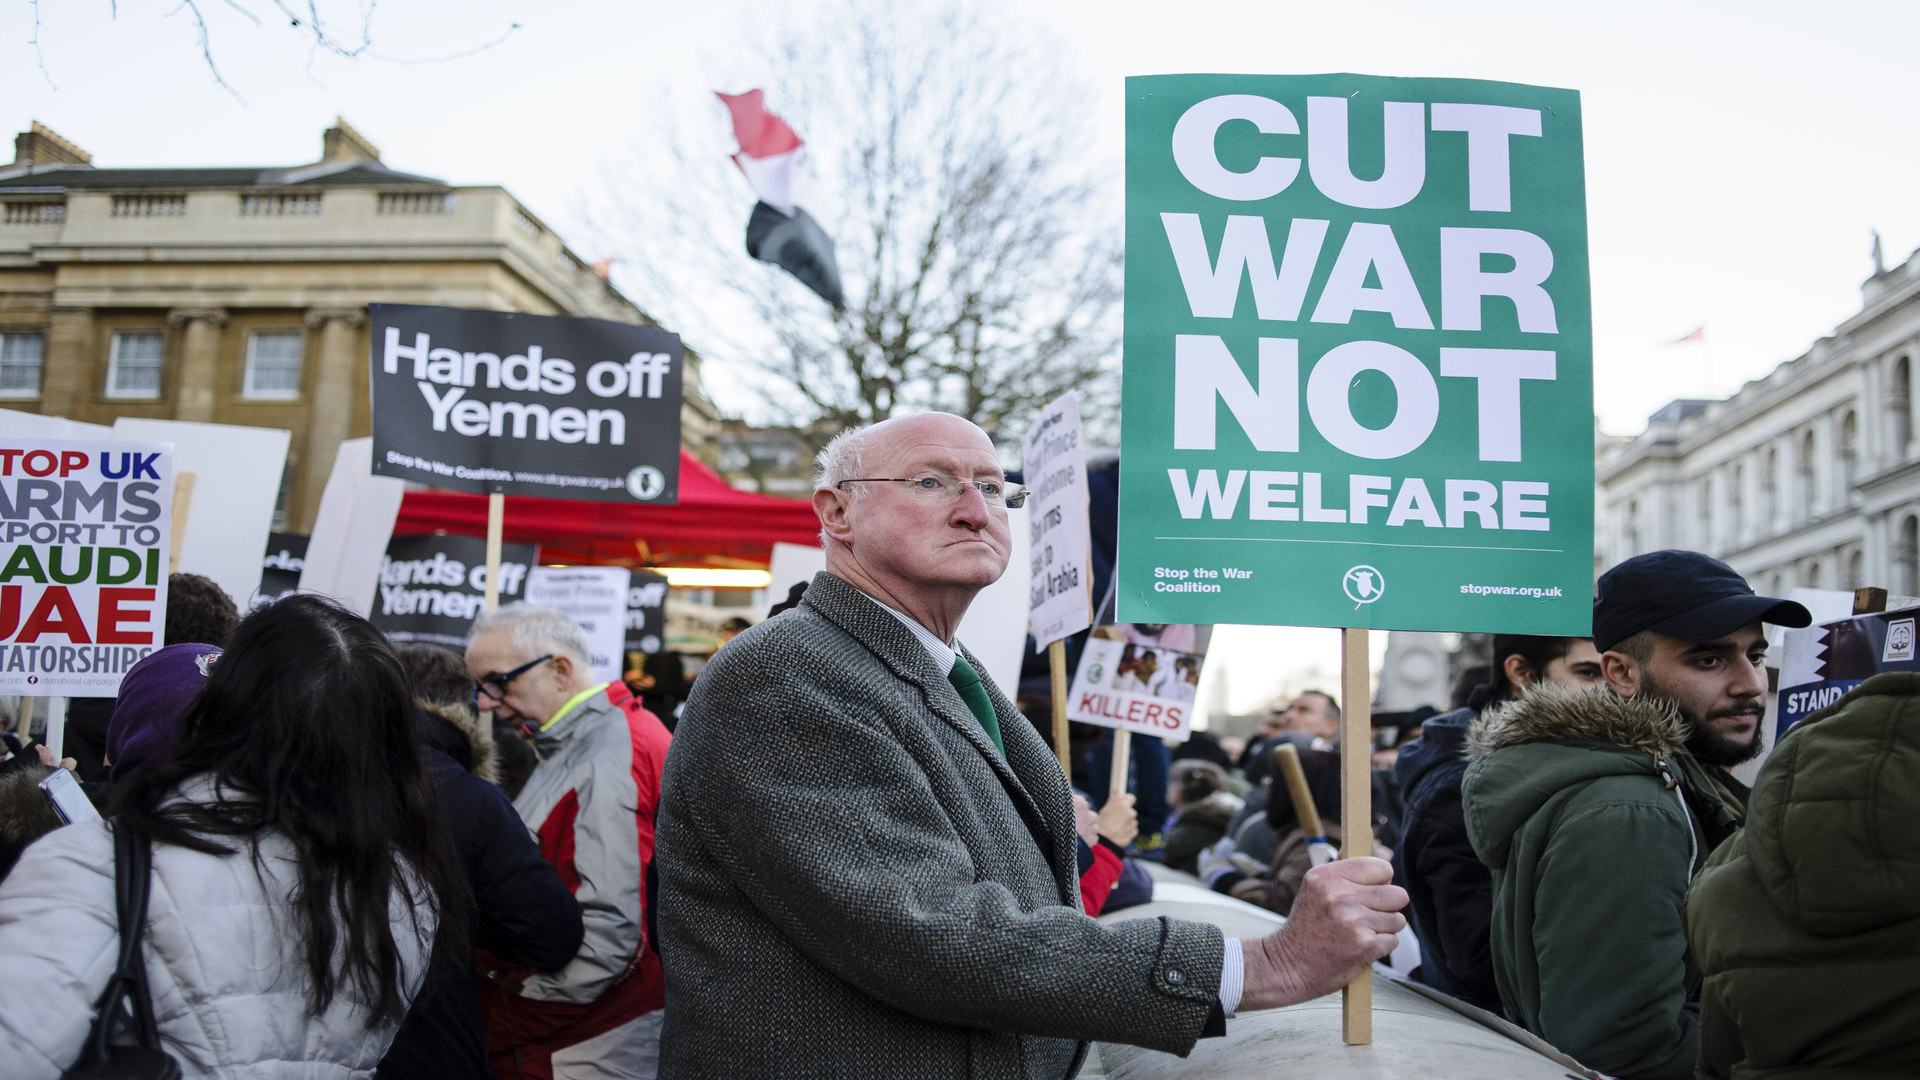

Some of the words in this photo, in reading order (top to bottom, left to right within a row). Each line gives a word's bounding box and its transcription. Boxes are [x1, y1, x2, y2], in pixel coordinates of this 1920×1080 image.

[1172, 94, 1542, 212] CUT
[1160, 212, 1559, 334] WAR
[384, 326, 576, 395] Hands
[586, 352, 671, 399] off
[417, 381, 626, 445] Yemen
[1174, 334, 1557, 462] NOT
[0, 449, 89, 478] TOP
[100, 452, 162, 480] UK
[1167, 468, 1550, 531] WELFARE
[113, 525, 160, 546] TO
[0, 544, 160, 586] AUDI
[1154, 567, 1189, 580] Stop
[1193, 568, 1218, 578] the
[1222, 568, 1253, 579] War
[1154, 581, 1221, 592] Coalition
[1460, 584, 1562, 598] stopwar.org.uk
[1079, 692, 1182, 729] KILLERS
[1787, 687, 1843, 714] STAND
